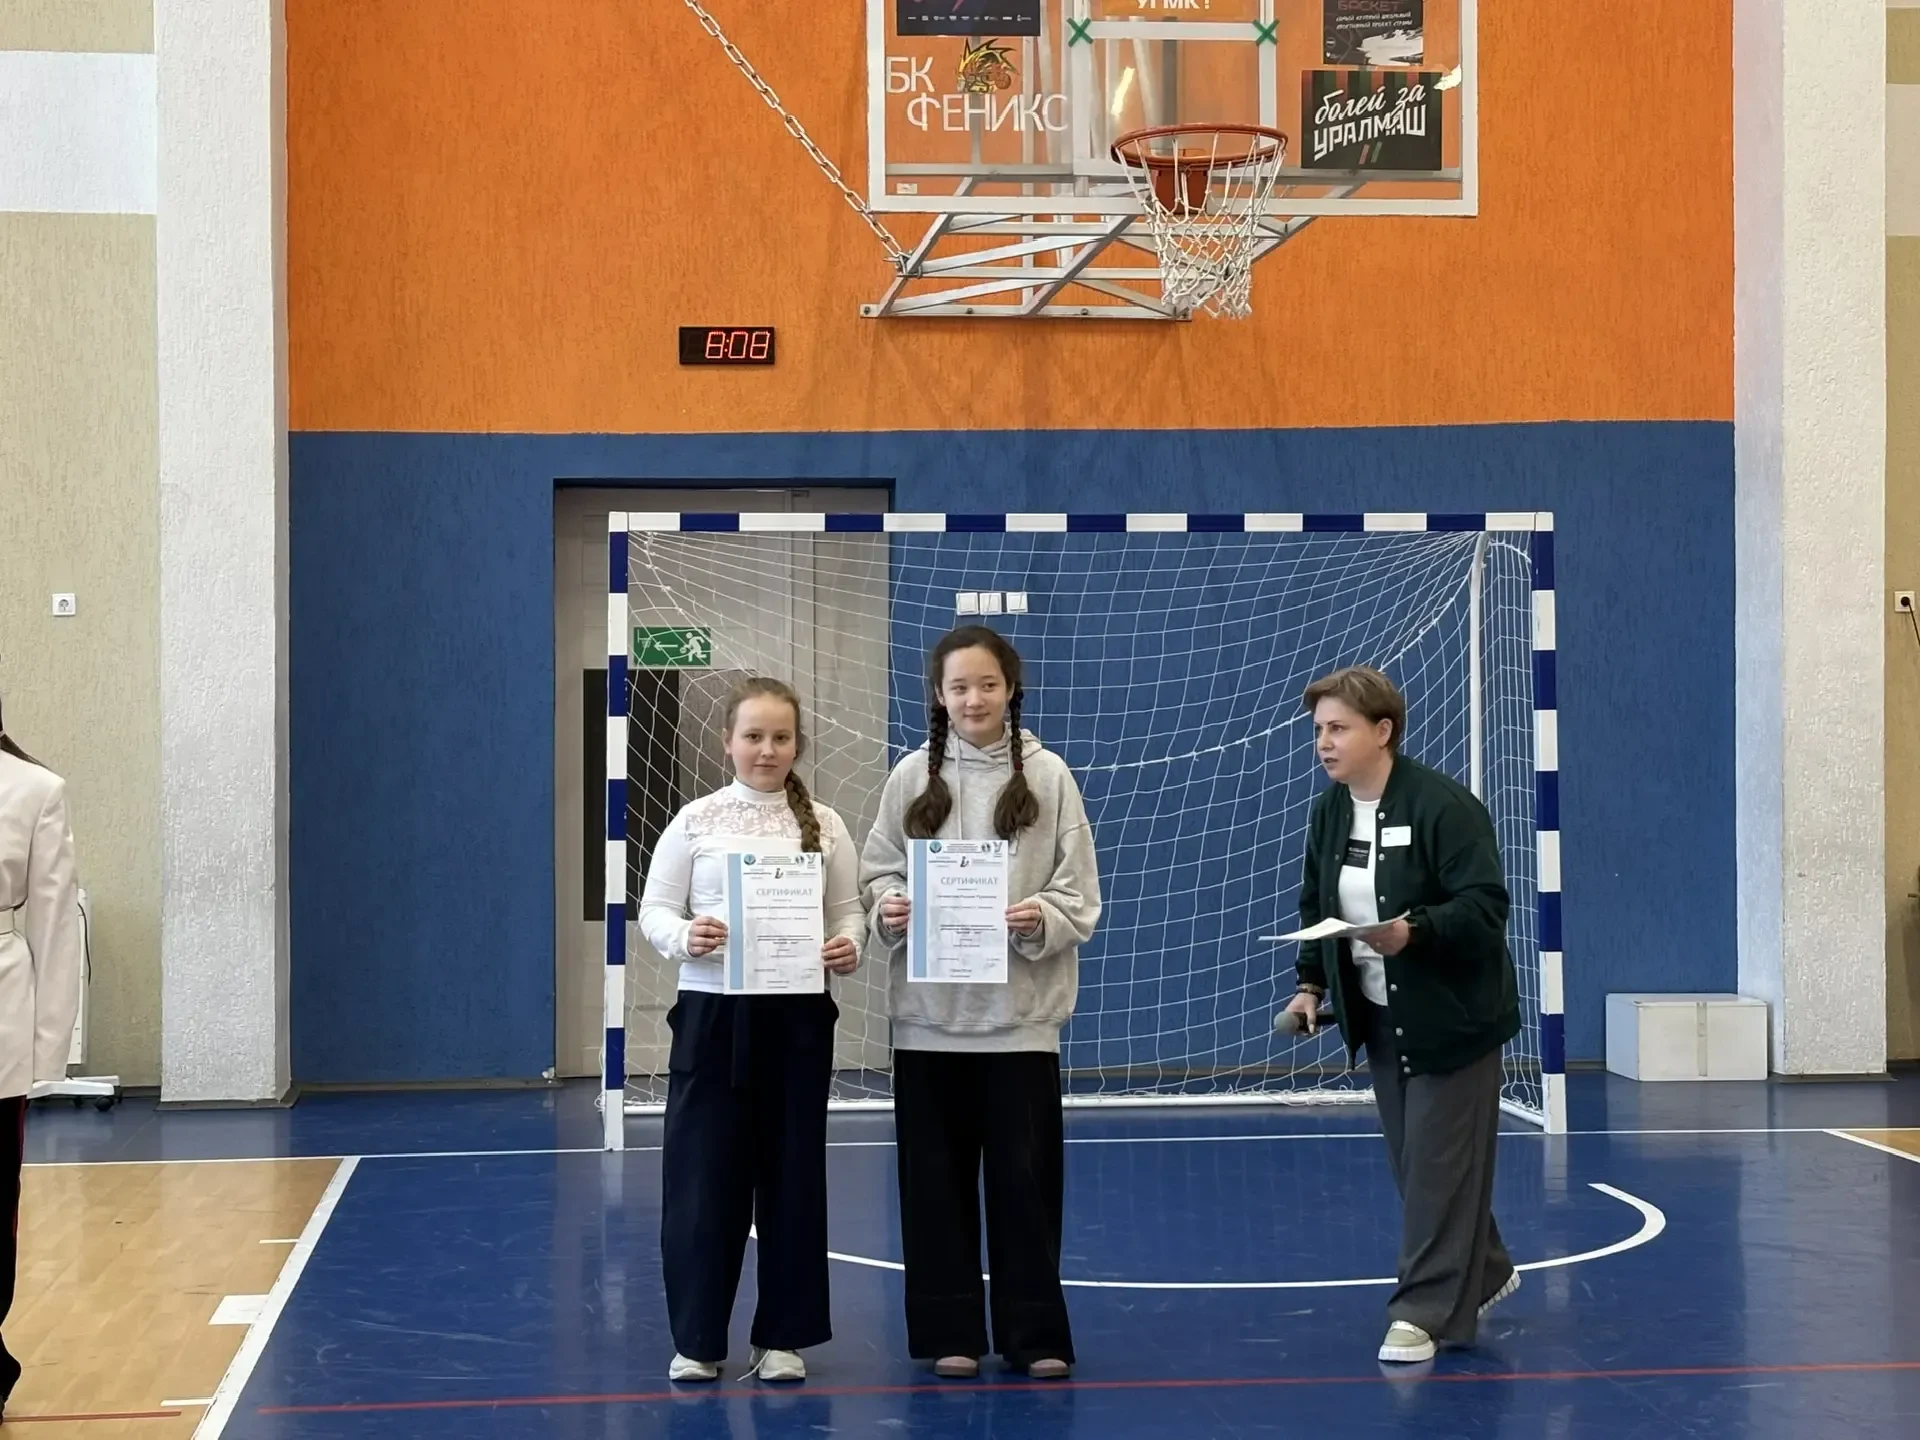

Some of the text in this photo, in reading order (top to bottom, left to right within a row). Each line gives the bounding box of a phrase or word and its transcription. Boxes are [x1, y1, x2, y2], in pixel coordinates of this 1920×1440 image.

[886, 56, 935, 93] БК
[907, 92, 1068, 132] ФЕНИКС
[1314, 86, 1386, 125] болей
[1314, 104, 1426, 161] УРАЛМАШ
[705, 331, 771, 359] 8:08
[756, 887, 813, 896] СЕРТИФИКАТ
[940, 876, 999, 885] СЕРТИФИКАТ
